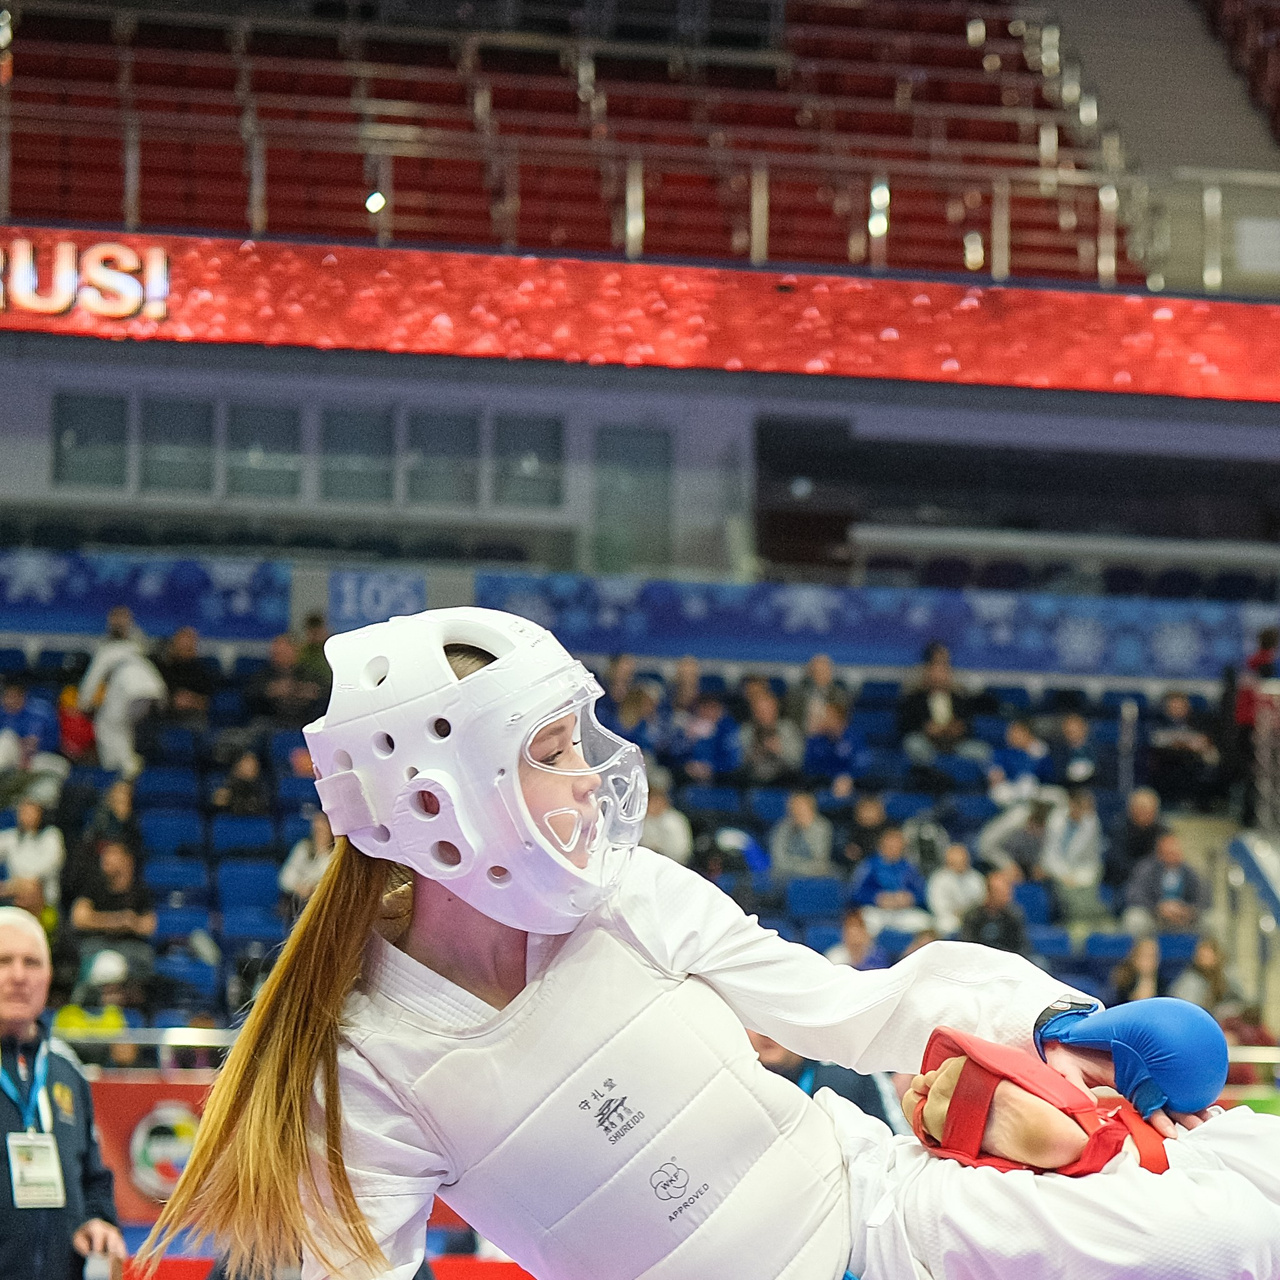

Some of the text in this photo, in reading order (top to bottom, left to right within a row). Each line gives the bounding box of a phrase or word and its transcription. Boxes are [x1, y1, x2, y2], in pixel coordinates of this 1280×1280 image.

[0, 238, 169, 319] US!
[608, 1111, 645, 1145] SHUREIDO
[661, 1172, 680, 1190] WKF
[667, 1183, 710, 1222] APPROVED
